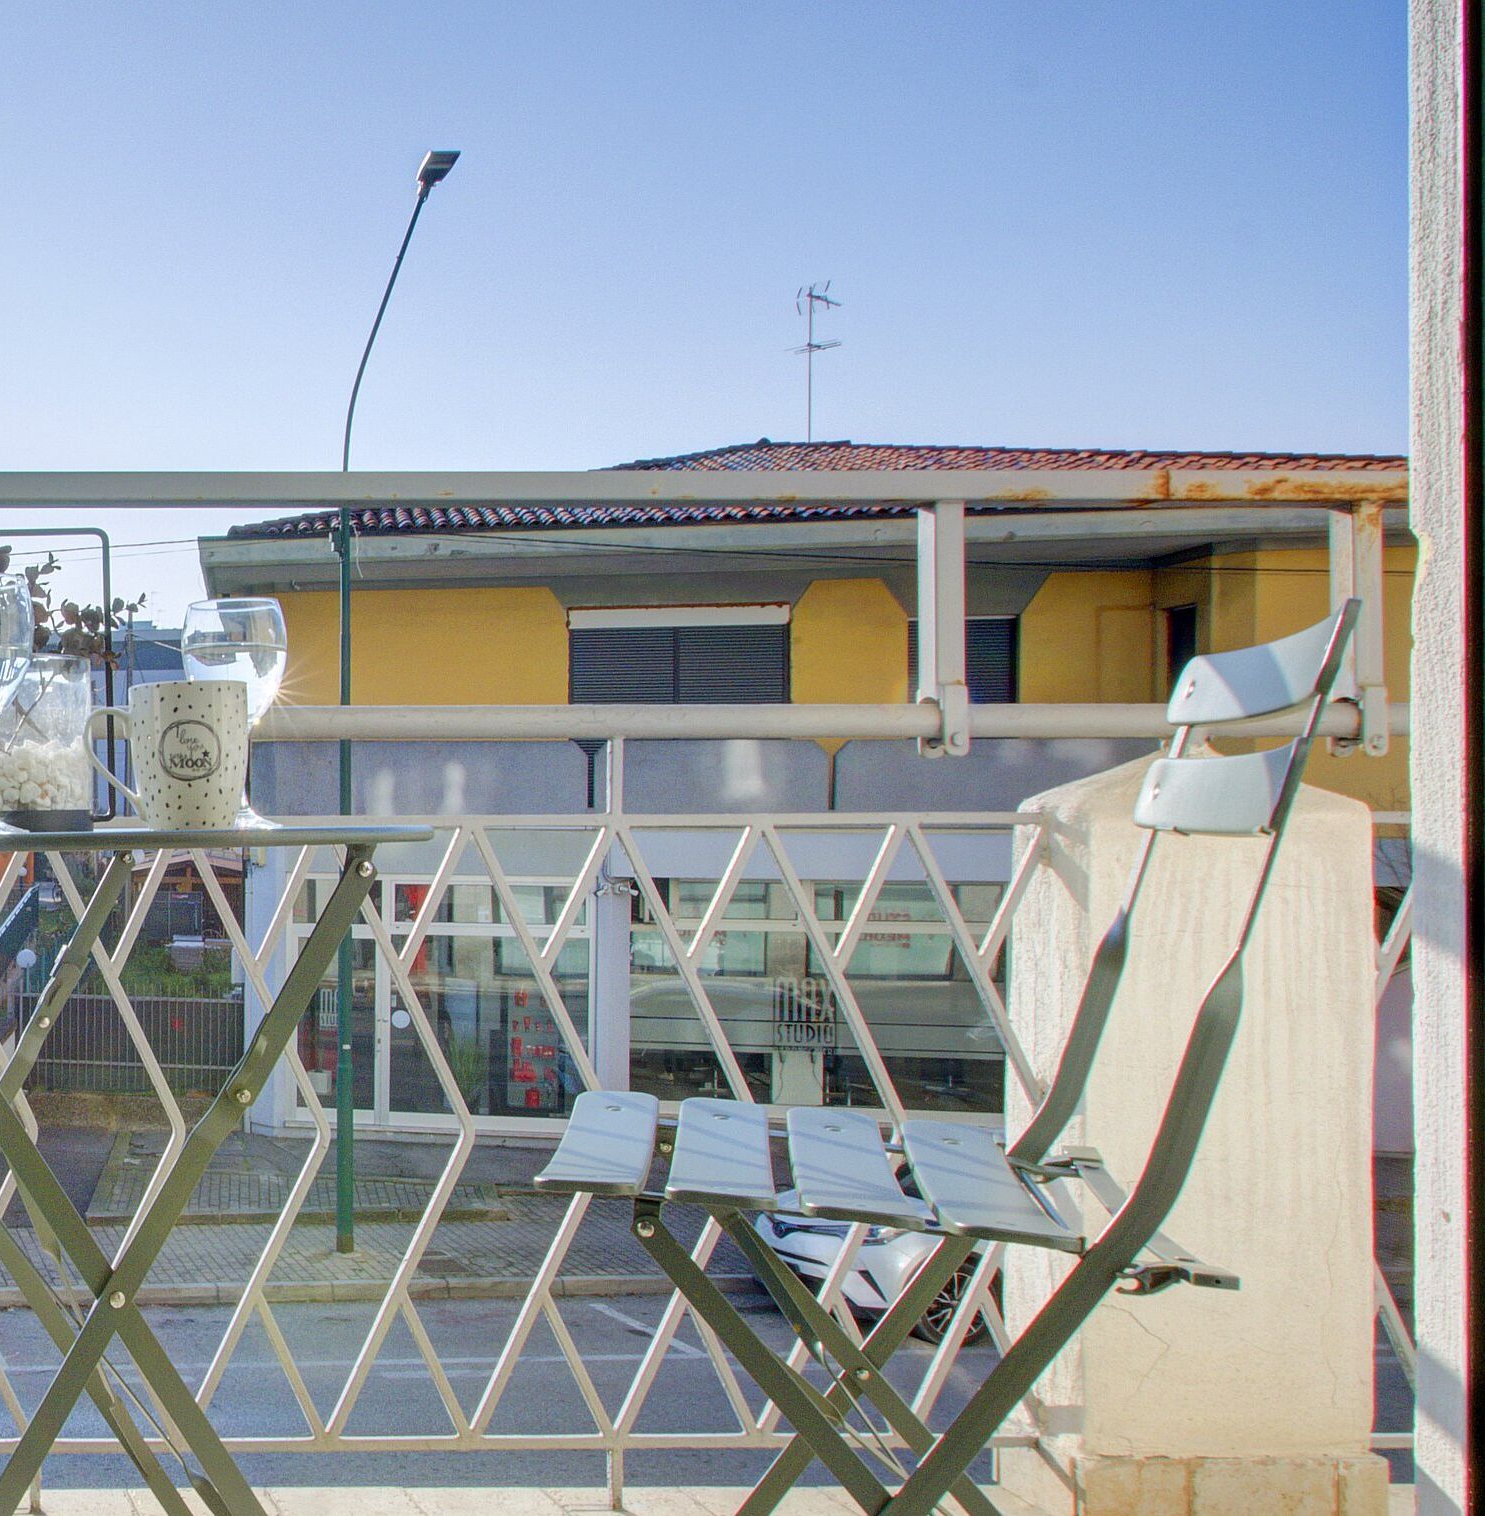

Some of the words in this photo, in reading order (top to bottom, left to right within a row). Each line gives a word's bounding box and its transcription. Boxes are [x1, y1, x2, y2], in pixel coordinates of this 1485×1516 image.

[179, 729, 199, 744] love
[170, 758, 212, 769] MOON
[777, 1023, 833, 1044] STUDIO
